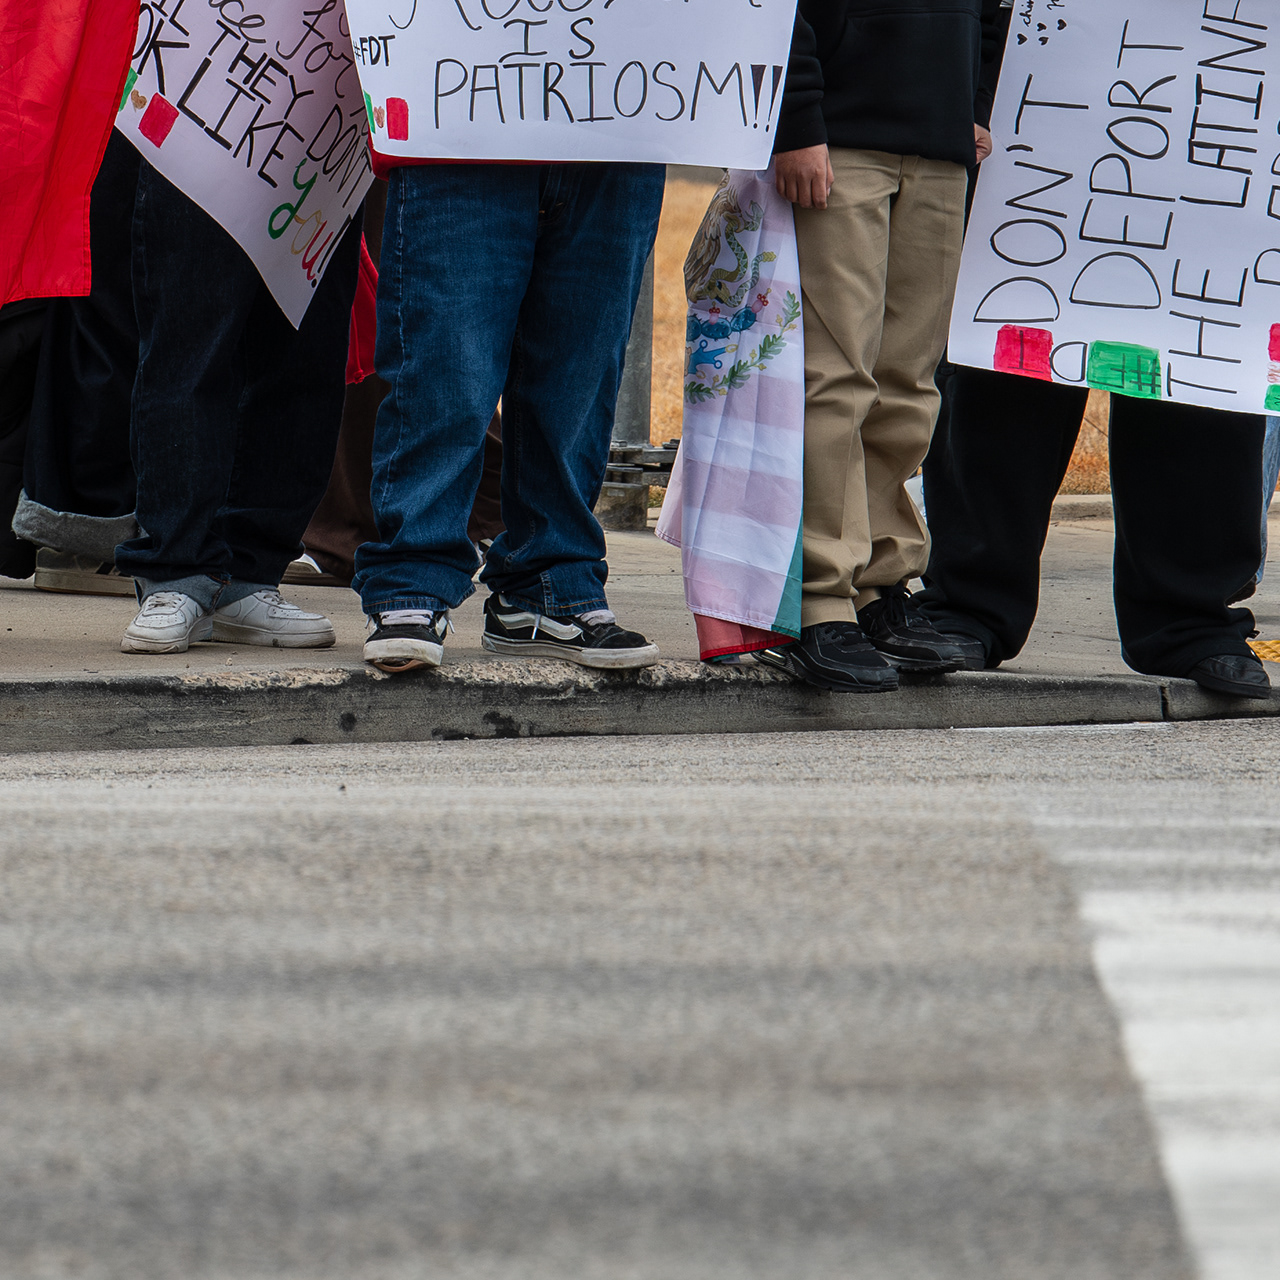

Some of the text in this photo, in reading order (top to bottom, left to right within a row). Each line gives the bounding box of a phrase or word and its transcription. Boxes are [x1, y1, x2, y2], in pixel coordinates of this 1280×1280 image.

[131, 3, 190, 96] OK
[177, 57, 305, 188] LIKE
[208, 19, 315, 120] THEY
[353, 34, 396, 67] #FDT
[434, 59, 783, 132] PATRIOSM!!
[499, 17, 597, 63] IS
[973, 73, 1090, 324] DON'T
[1069, 19, 1185, 310] DEPORT
[1168, 258, 1248, 398] THE
